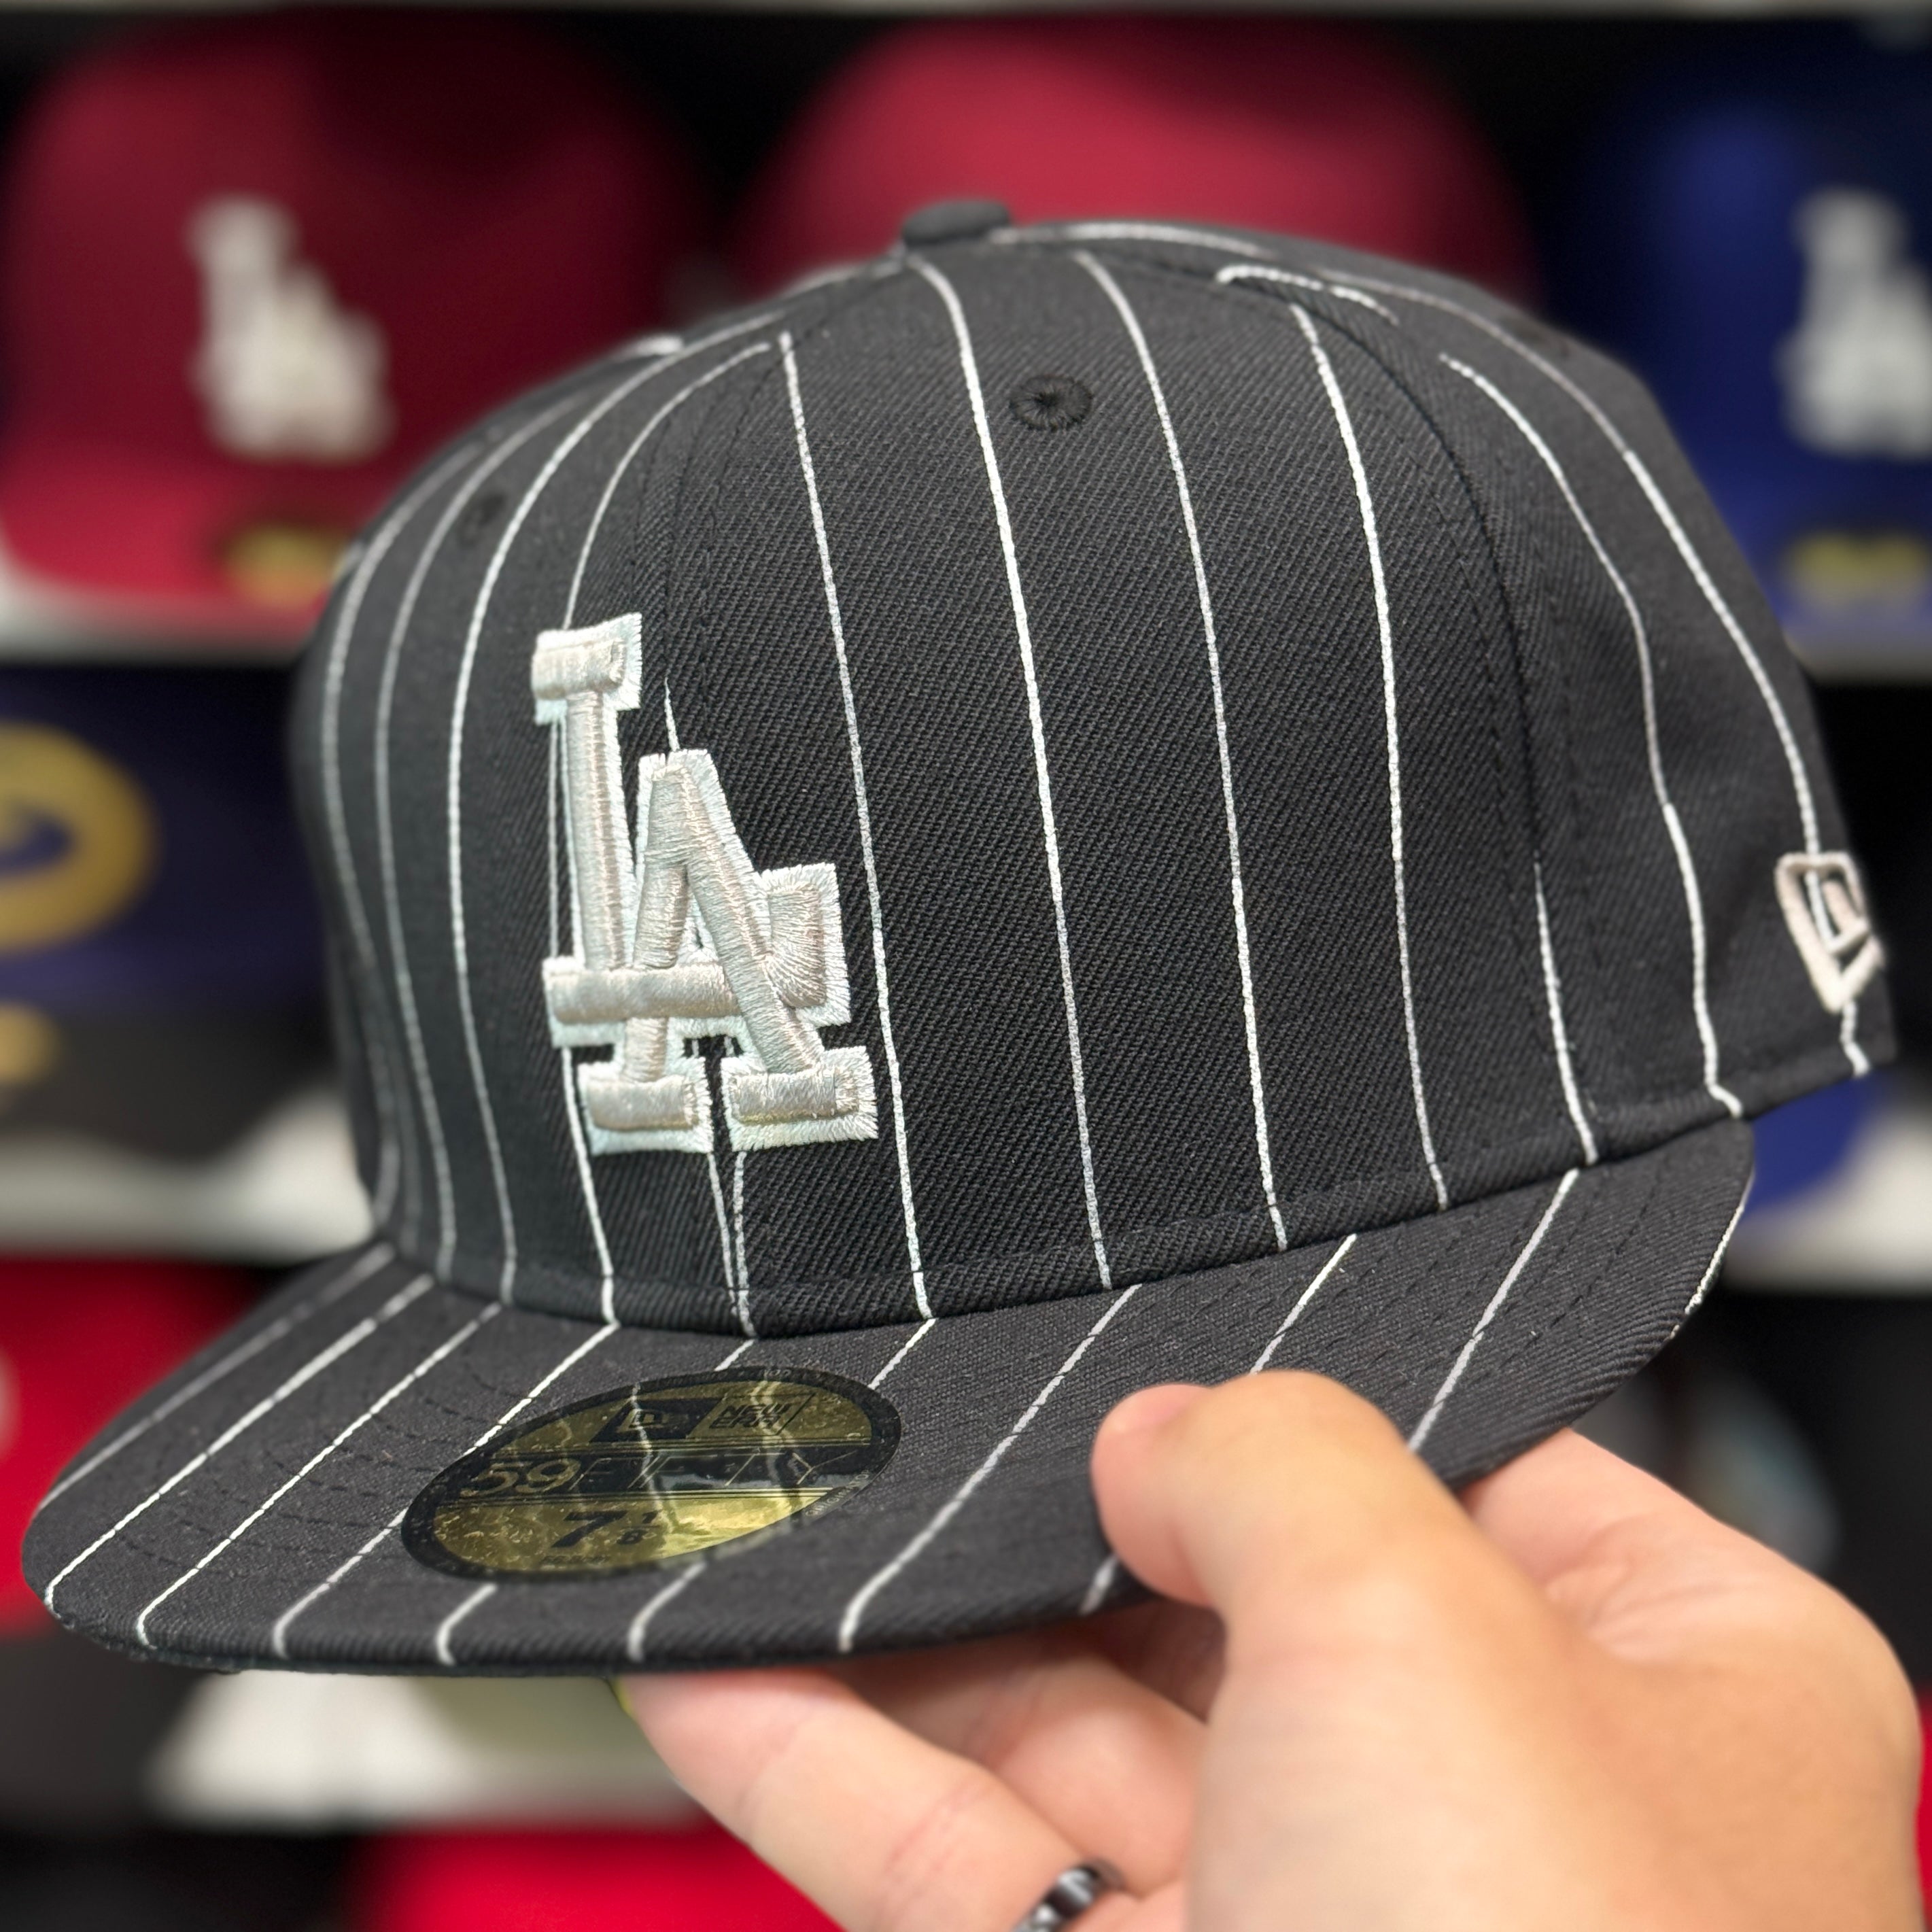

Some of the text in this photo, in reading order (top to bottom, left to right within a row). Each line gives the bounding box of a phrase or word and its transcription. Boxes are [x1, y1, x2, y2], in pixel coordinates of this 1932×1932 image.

[531, 612, 878, 1156] LA
[709, 1415, 781, 1428] ERA
[717, 1402, 794, 1417] NEW
[550, 1510, 629, 1548] 7
